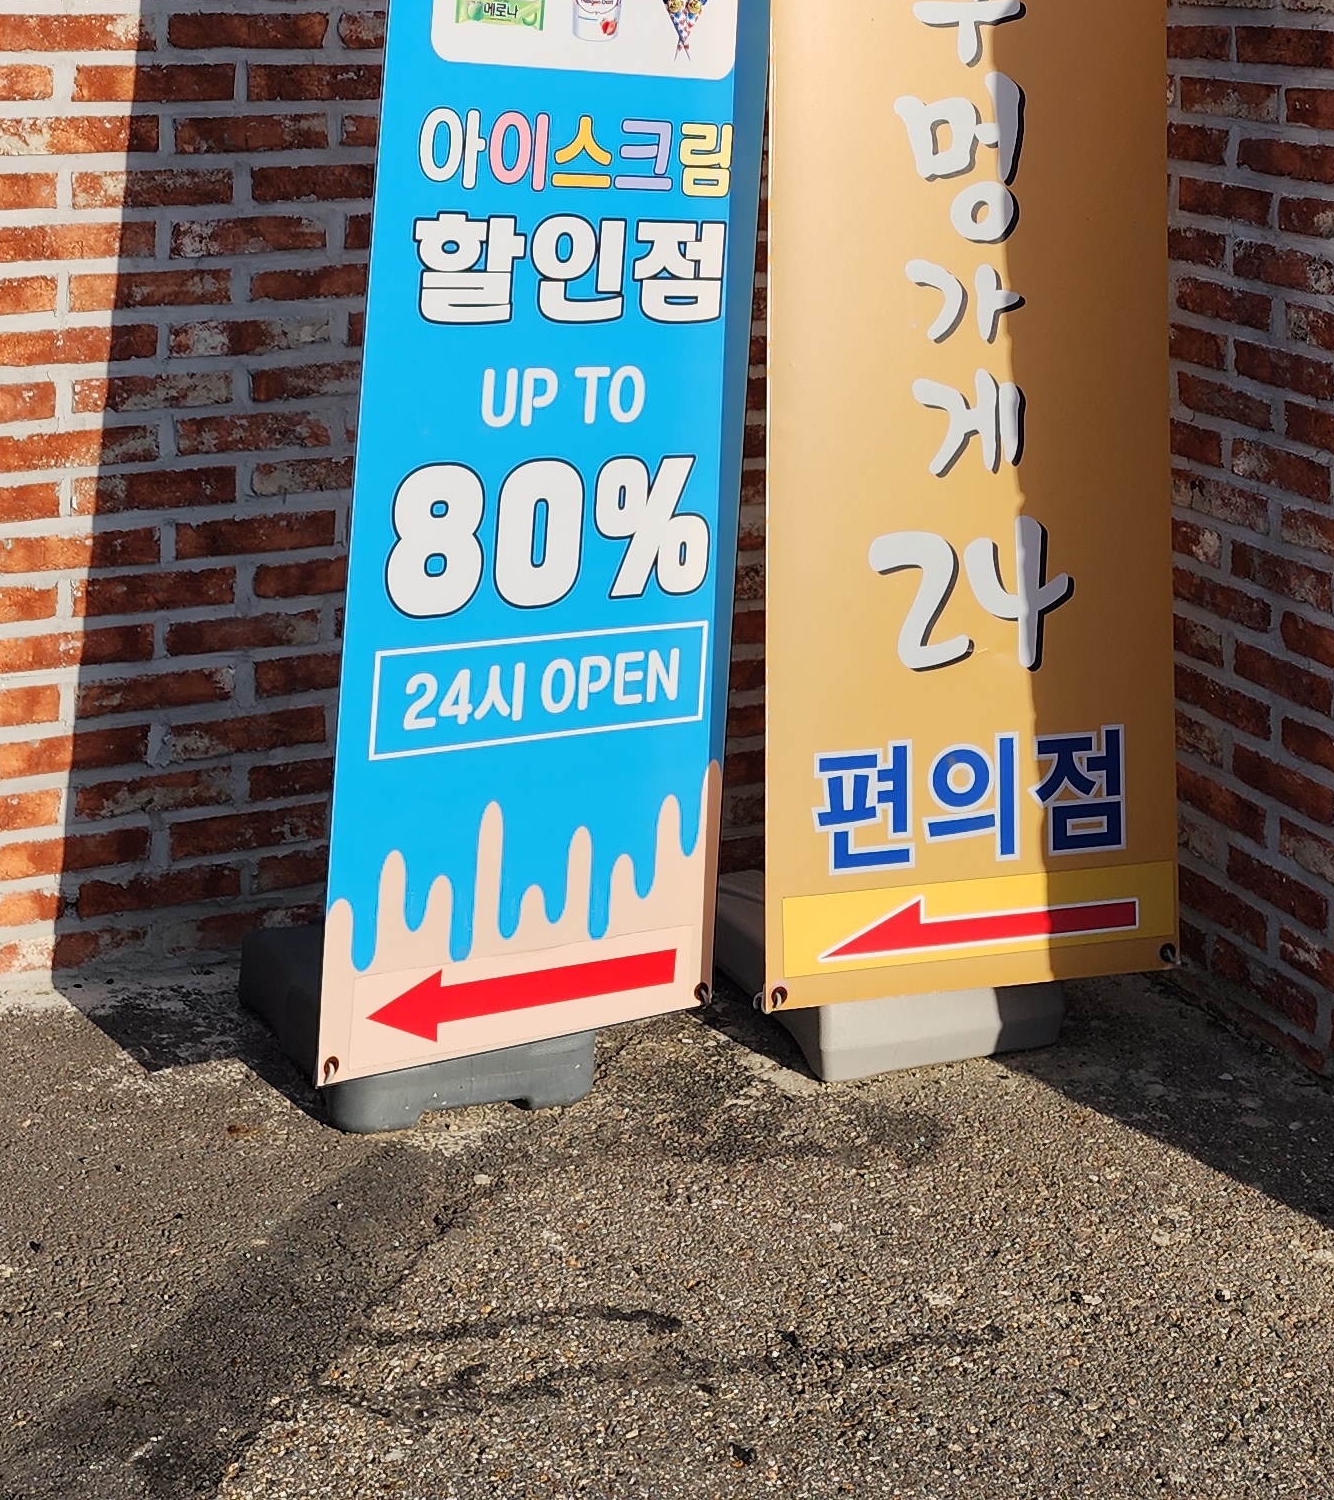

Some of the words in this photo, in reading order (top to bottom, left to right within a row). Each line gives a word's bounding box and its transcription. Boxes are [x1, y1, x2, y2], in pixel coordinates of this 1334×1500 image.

[483, 2, 519, 19] 메로나
[418, 106, 734, 198] 아이스크림
[413, 211, 728, 325] 할인점
[480, 366, 559, 428] UP
[574, 364, 647, 425] TO
[384, 455, 710, 619] 80%
[402, 661, 526, 731] 24시
[540, 647, 680, 714] OPEN
[811, 723, 1127, 876] 편의점
